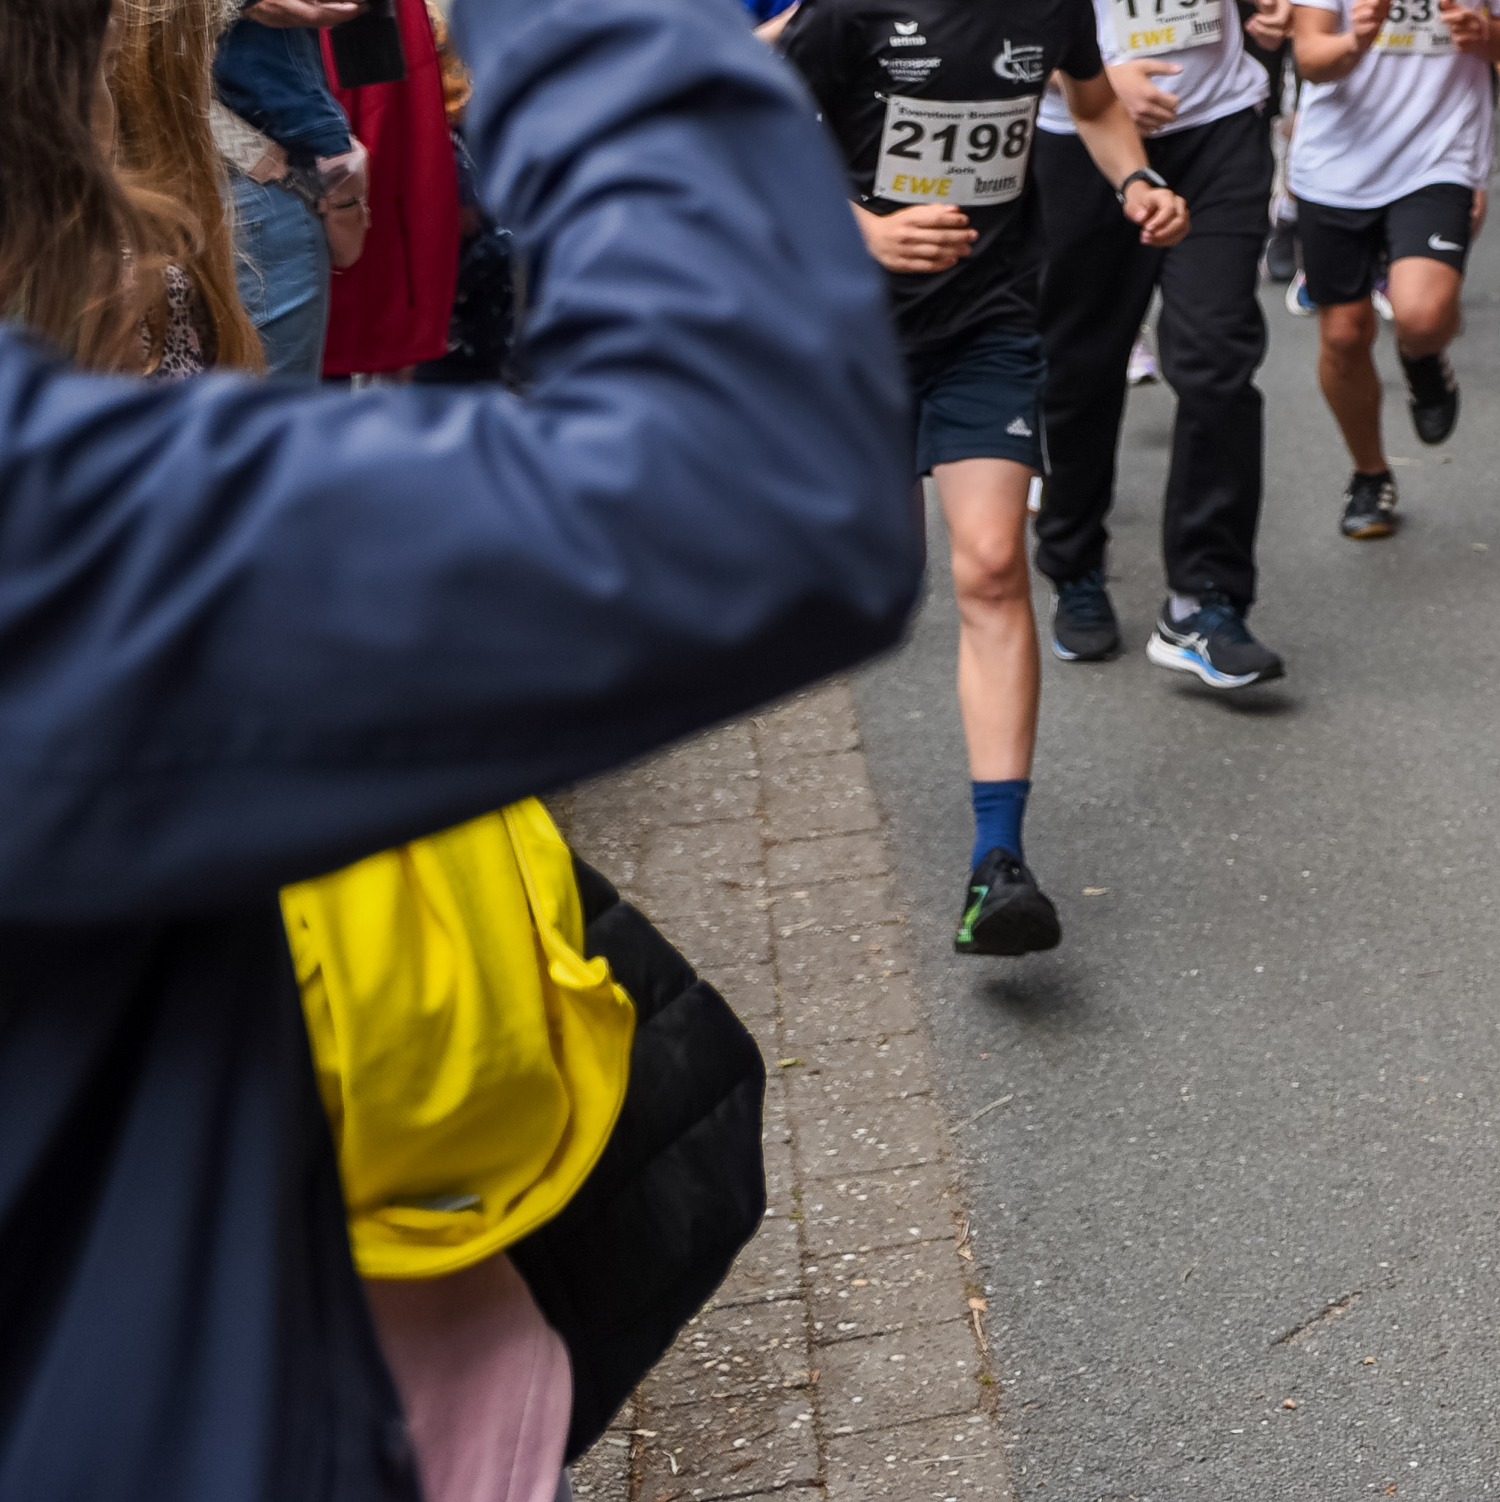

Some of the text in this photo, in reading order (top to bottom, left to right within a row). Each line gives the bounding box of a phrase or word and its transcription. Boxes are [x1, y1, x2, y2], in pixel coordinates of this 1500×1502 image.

[1129, 26, 1175, 49] EWE
[887, 118, 1029, 163] 2198
[892, 173, 952, 196] EWE
